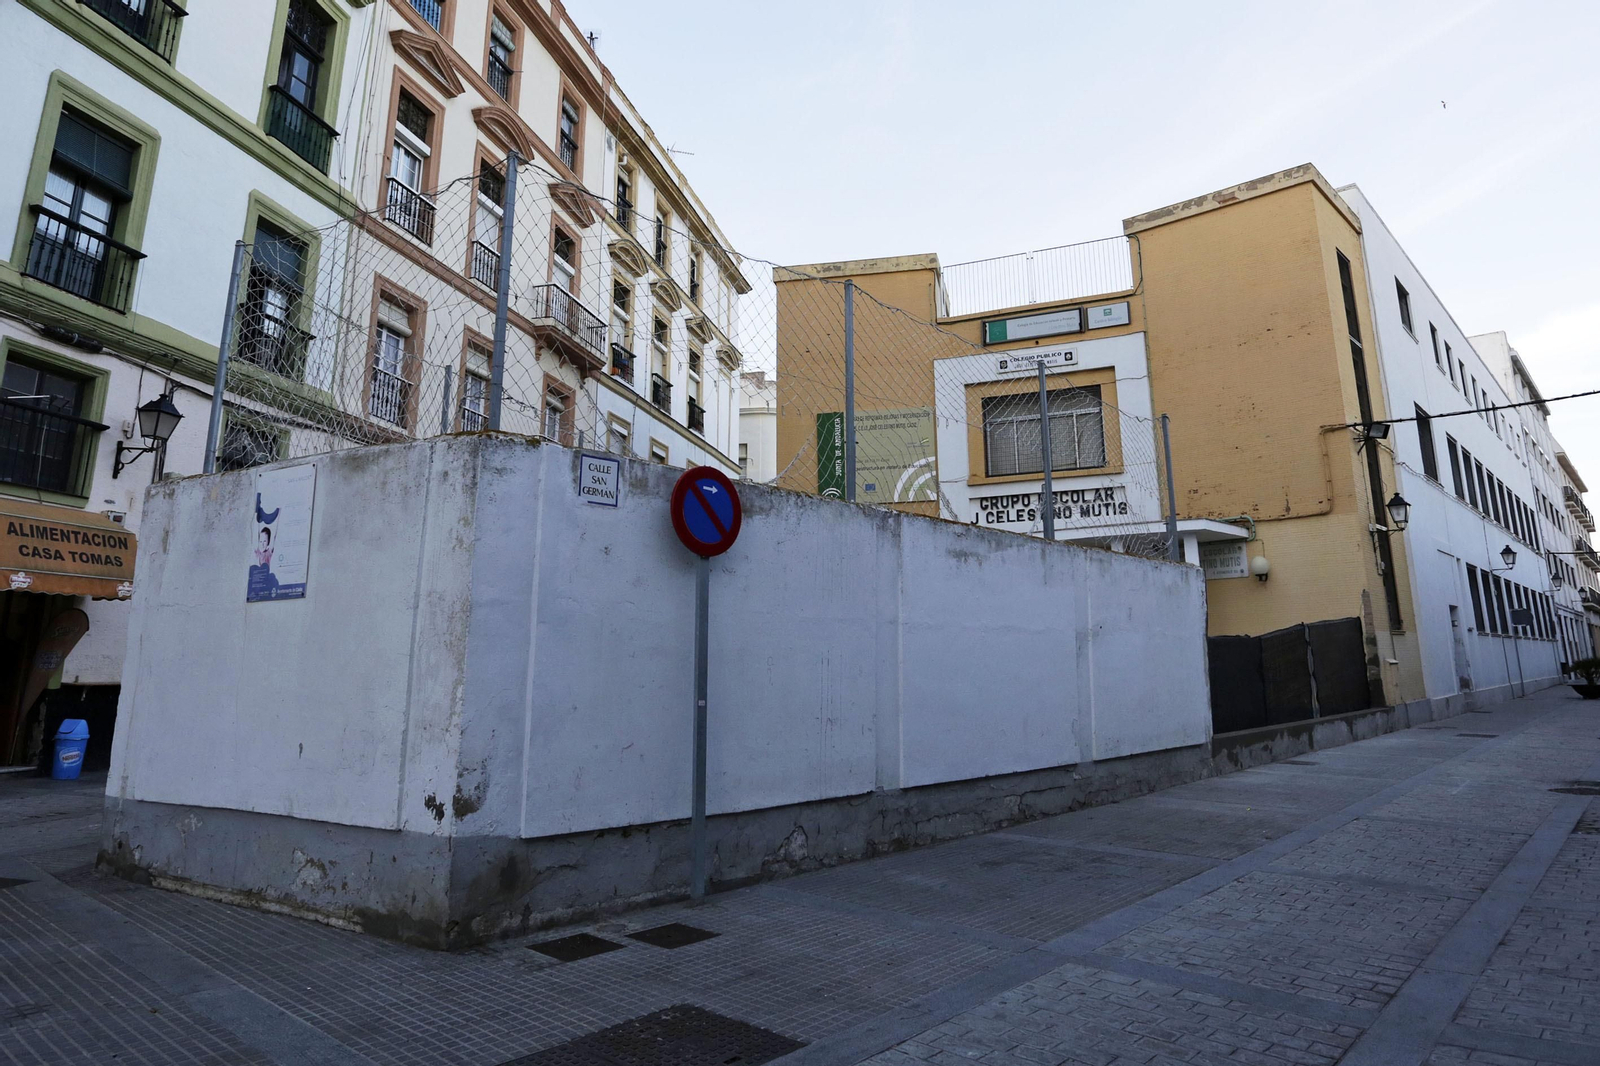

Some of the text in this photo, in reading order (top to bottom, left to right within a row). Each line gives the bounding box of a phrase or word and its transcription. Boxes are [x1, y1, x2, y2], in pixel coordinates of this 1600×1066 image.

[588, 463, 611, 474] CALLE
[591, 475, 607, 486] SAN
[582, 486, 615, 499] GERMÁN
[979, 494, 1031, 511] GRUPO
[970, 502, 1128, 525] J CELESNO MUTIS
[7, 521, 128, 550] ALIMENTACION
[18, 545, 123, 567] CASA TOMAS
[1219, 556, 1241, 568] MUTIS
